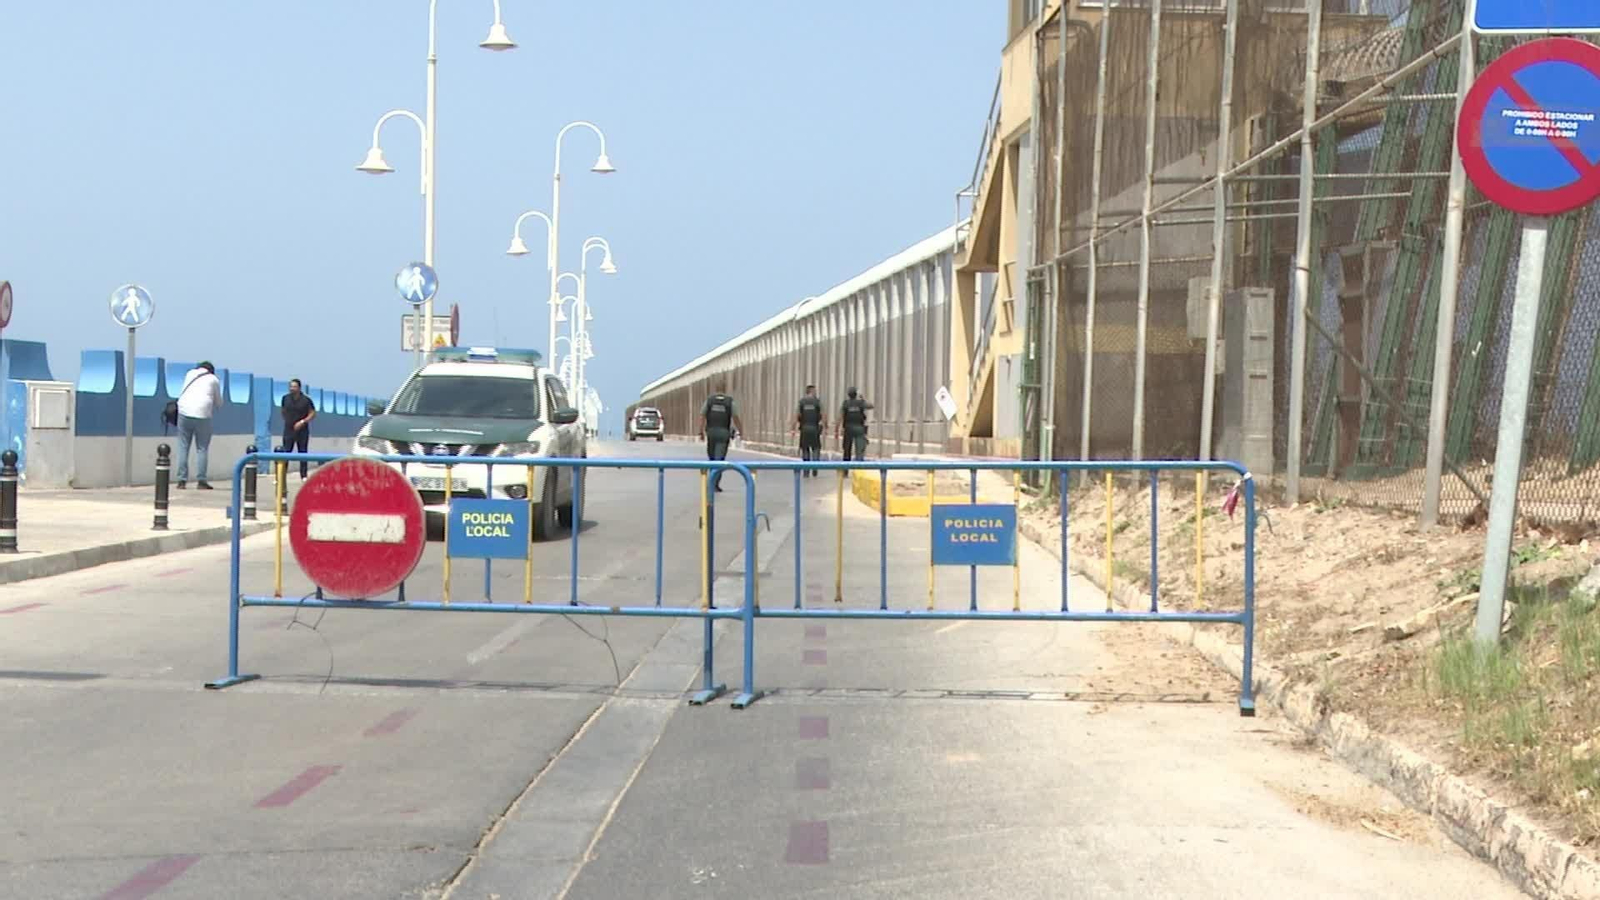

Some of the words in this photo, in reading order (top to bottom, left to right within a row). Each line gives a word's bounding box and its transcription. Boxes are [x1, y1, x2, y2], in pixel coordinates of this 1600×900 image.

[1501, 109, 1545, 119] PROHIBIDO
[1545, 111, 1595, 121] ESTACIONAR
[1515, 119, 1522, 127] A
[1523, 120, 1550, 128] AMBOS
[1551, 121, 1578, 129] LADOS
[462, 513, 514, 524] POLICIA
[944, 519, 1004, 528] POLICIA
[466, 526, 511, 537] LOCAL
[951, 533, 999, 542] LOCAL
